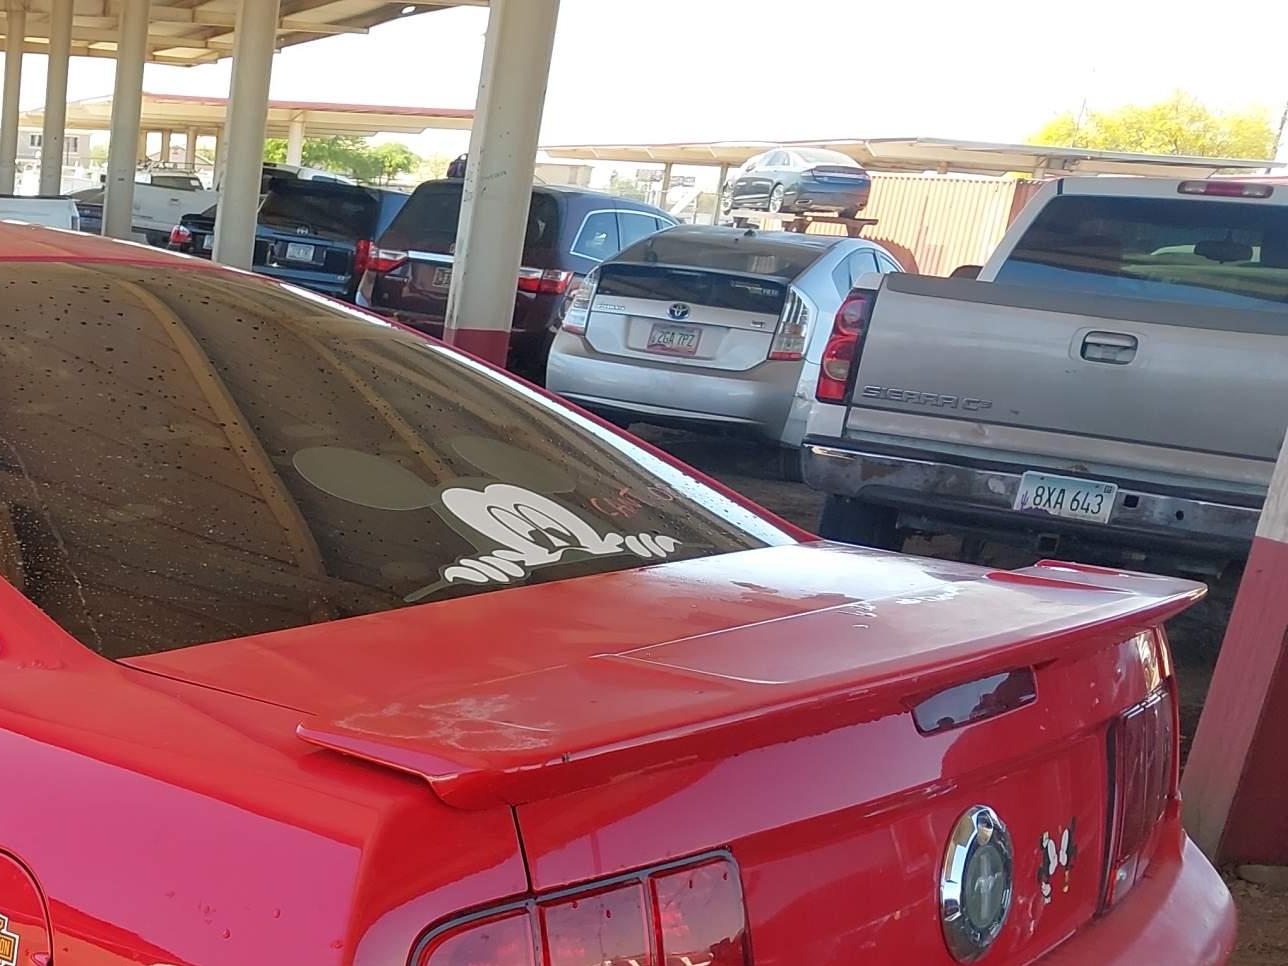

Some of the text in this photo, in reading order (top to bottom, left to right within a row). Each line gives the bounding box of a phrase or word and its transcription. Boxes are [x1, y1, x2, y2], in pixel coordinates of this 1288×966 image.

[862, 385, 959, 409] SIERRA
[1032, 485, 1104, 515] 8XA 643
